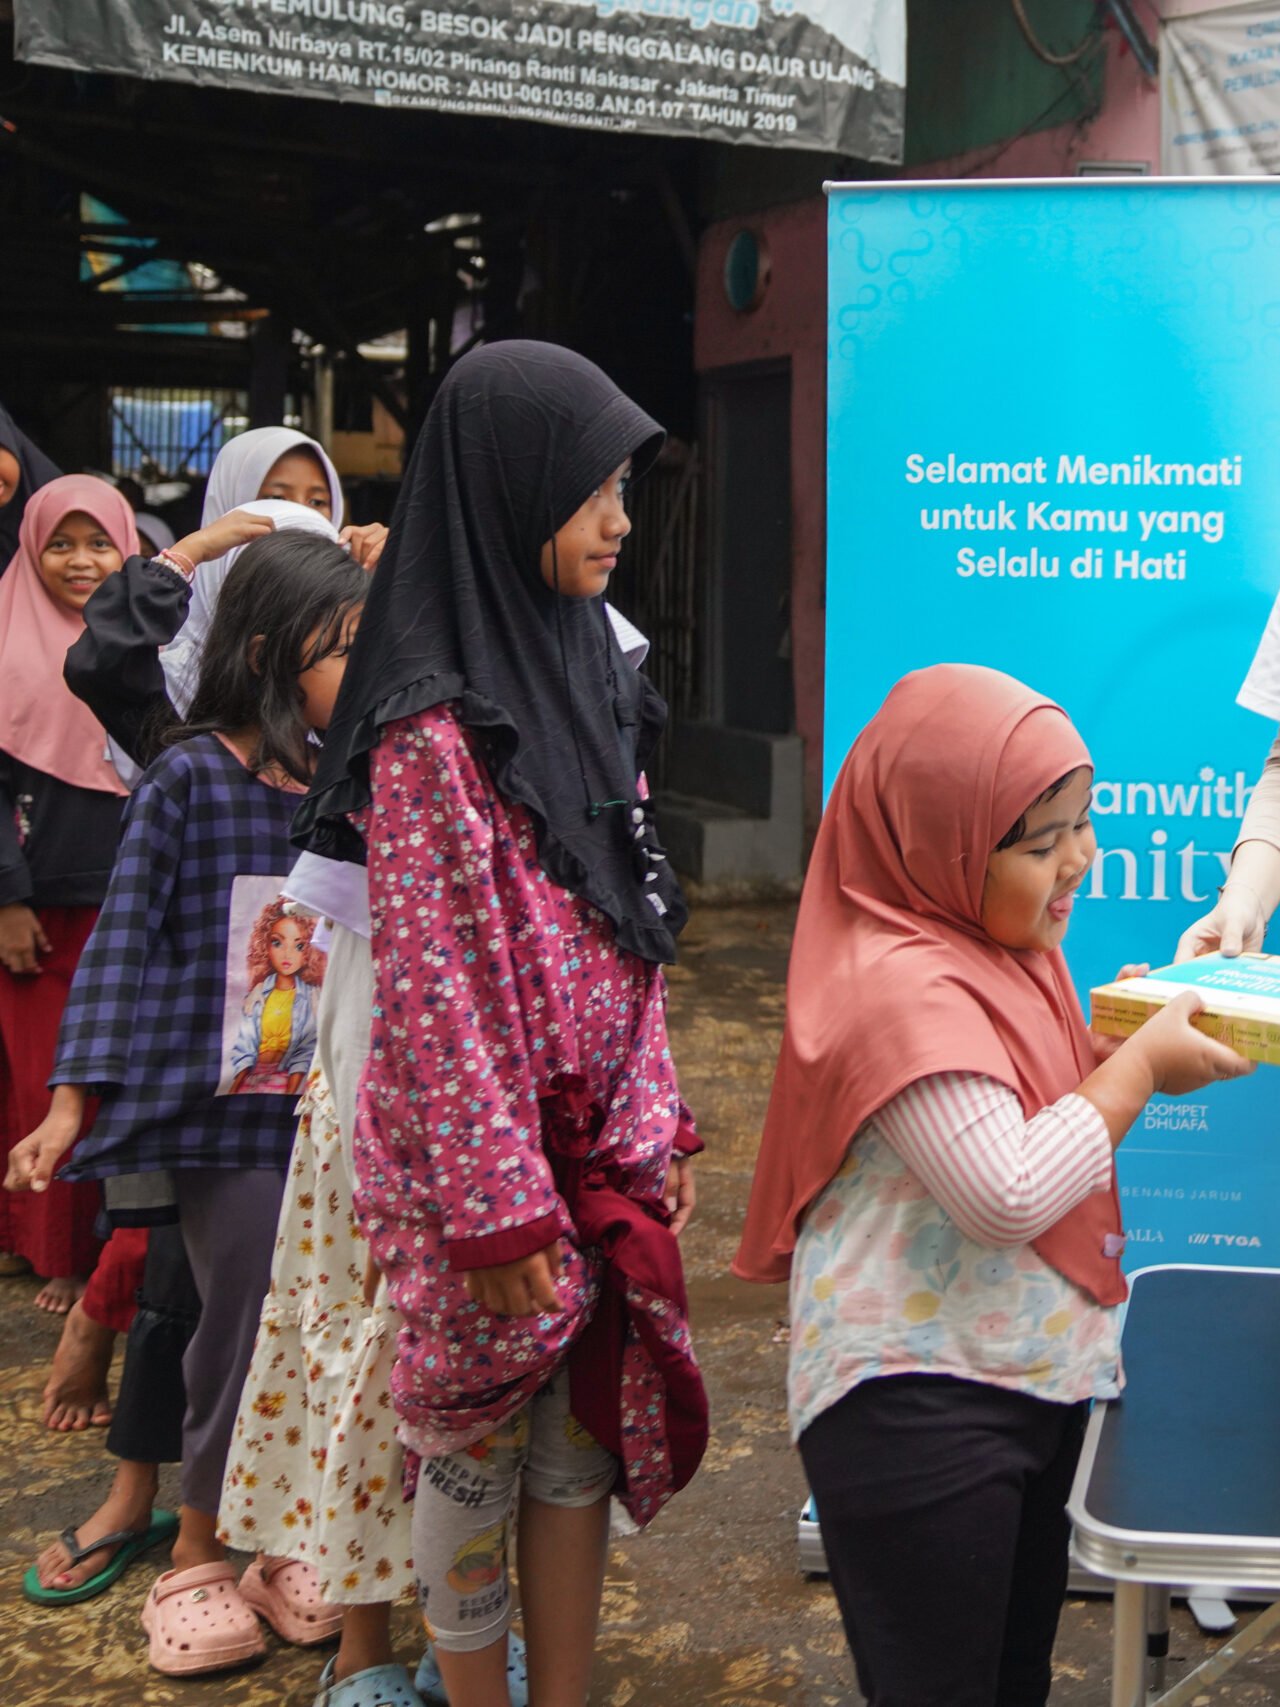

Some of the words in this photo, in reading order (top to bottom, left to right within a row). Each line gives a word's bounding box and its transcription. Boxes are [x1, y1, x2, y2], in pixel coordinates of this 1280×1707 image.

[163, 14, 191, 36] Jl.
[197, 19, 262, 46] Asem
[268, 29, 352, 59] Nirbaya
[358, 40, 446, 69] RT.15/02
[451, 53, 521, 80] Pinang
[526, 59, 576, 84] Ranti
[580, 67, 660, 93] Makasar
[675, 79, 740, 104] Jakarta
[743, 86, 797, 109] Timur
[420, 9, 509, 42] BESOK
[514, 22, 572, 49] JADI
[577, 30, 735, 70] PENGGALANG
[740, 51, 805, 78] DAUR
[809, 60, 875, 91] ULANG
[162, 42, 303, 78] KEMENKUM
[309, 61, 360, 85] HAM
[366, 69, 450, 94] NOMOR
[690, 103, 751, 128] TAHUN
[753, 112, 798, 132] 2019
[904, 453, 1046, 485] Selamat
[1056, 454, 1243, 486] Menikmati
[920, 501, 1017, 532] untuk
[1026, 502, 1128, 533] Kamu
[1138, 508, 1225, 543] yang
[955, 547, 1060, 578] Selalu
[1069, 548, 1103, 579] di
[1113, 550, 1188, 581] Hati
[1090, 766, 1254, 818] anwith
[1143, 1116, 1209, 1132] DHUAFA
[1144, 1103, 1209, 1118] DOMPET
[1121, 1186, 1186, 1200] BENANG
[1189, 1190, 1243, 1202] JARUM
[1211, 1234, 1263, 1248] TYGA
[424, 1461, 486, 1509] FRESH
